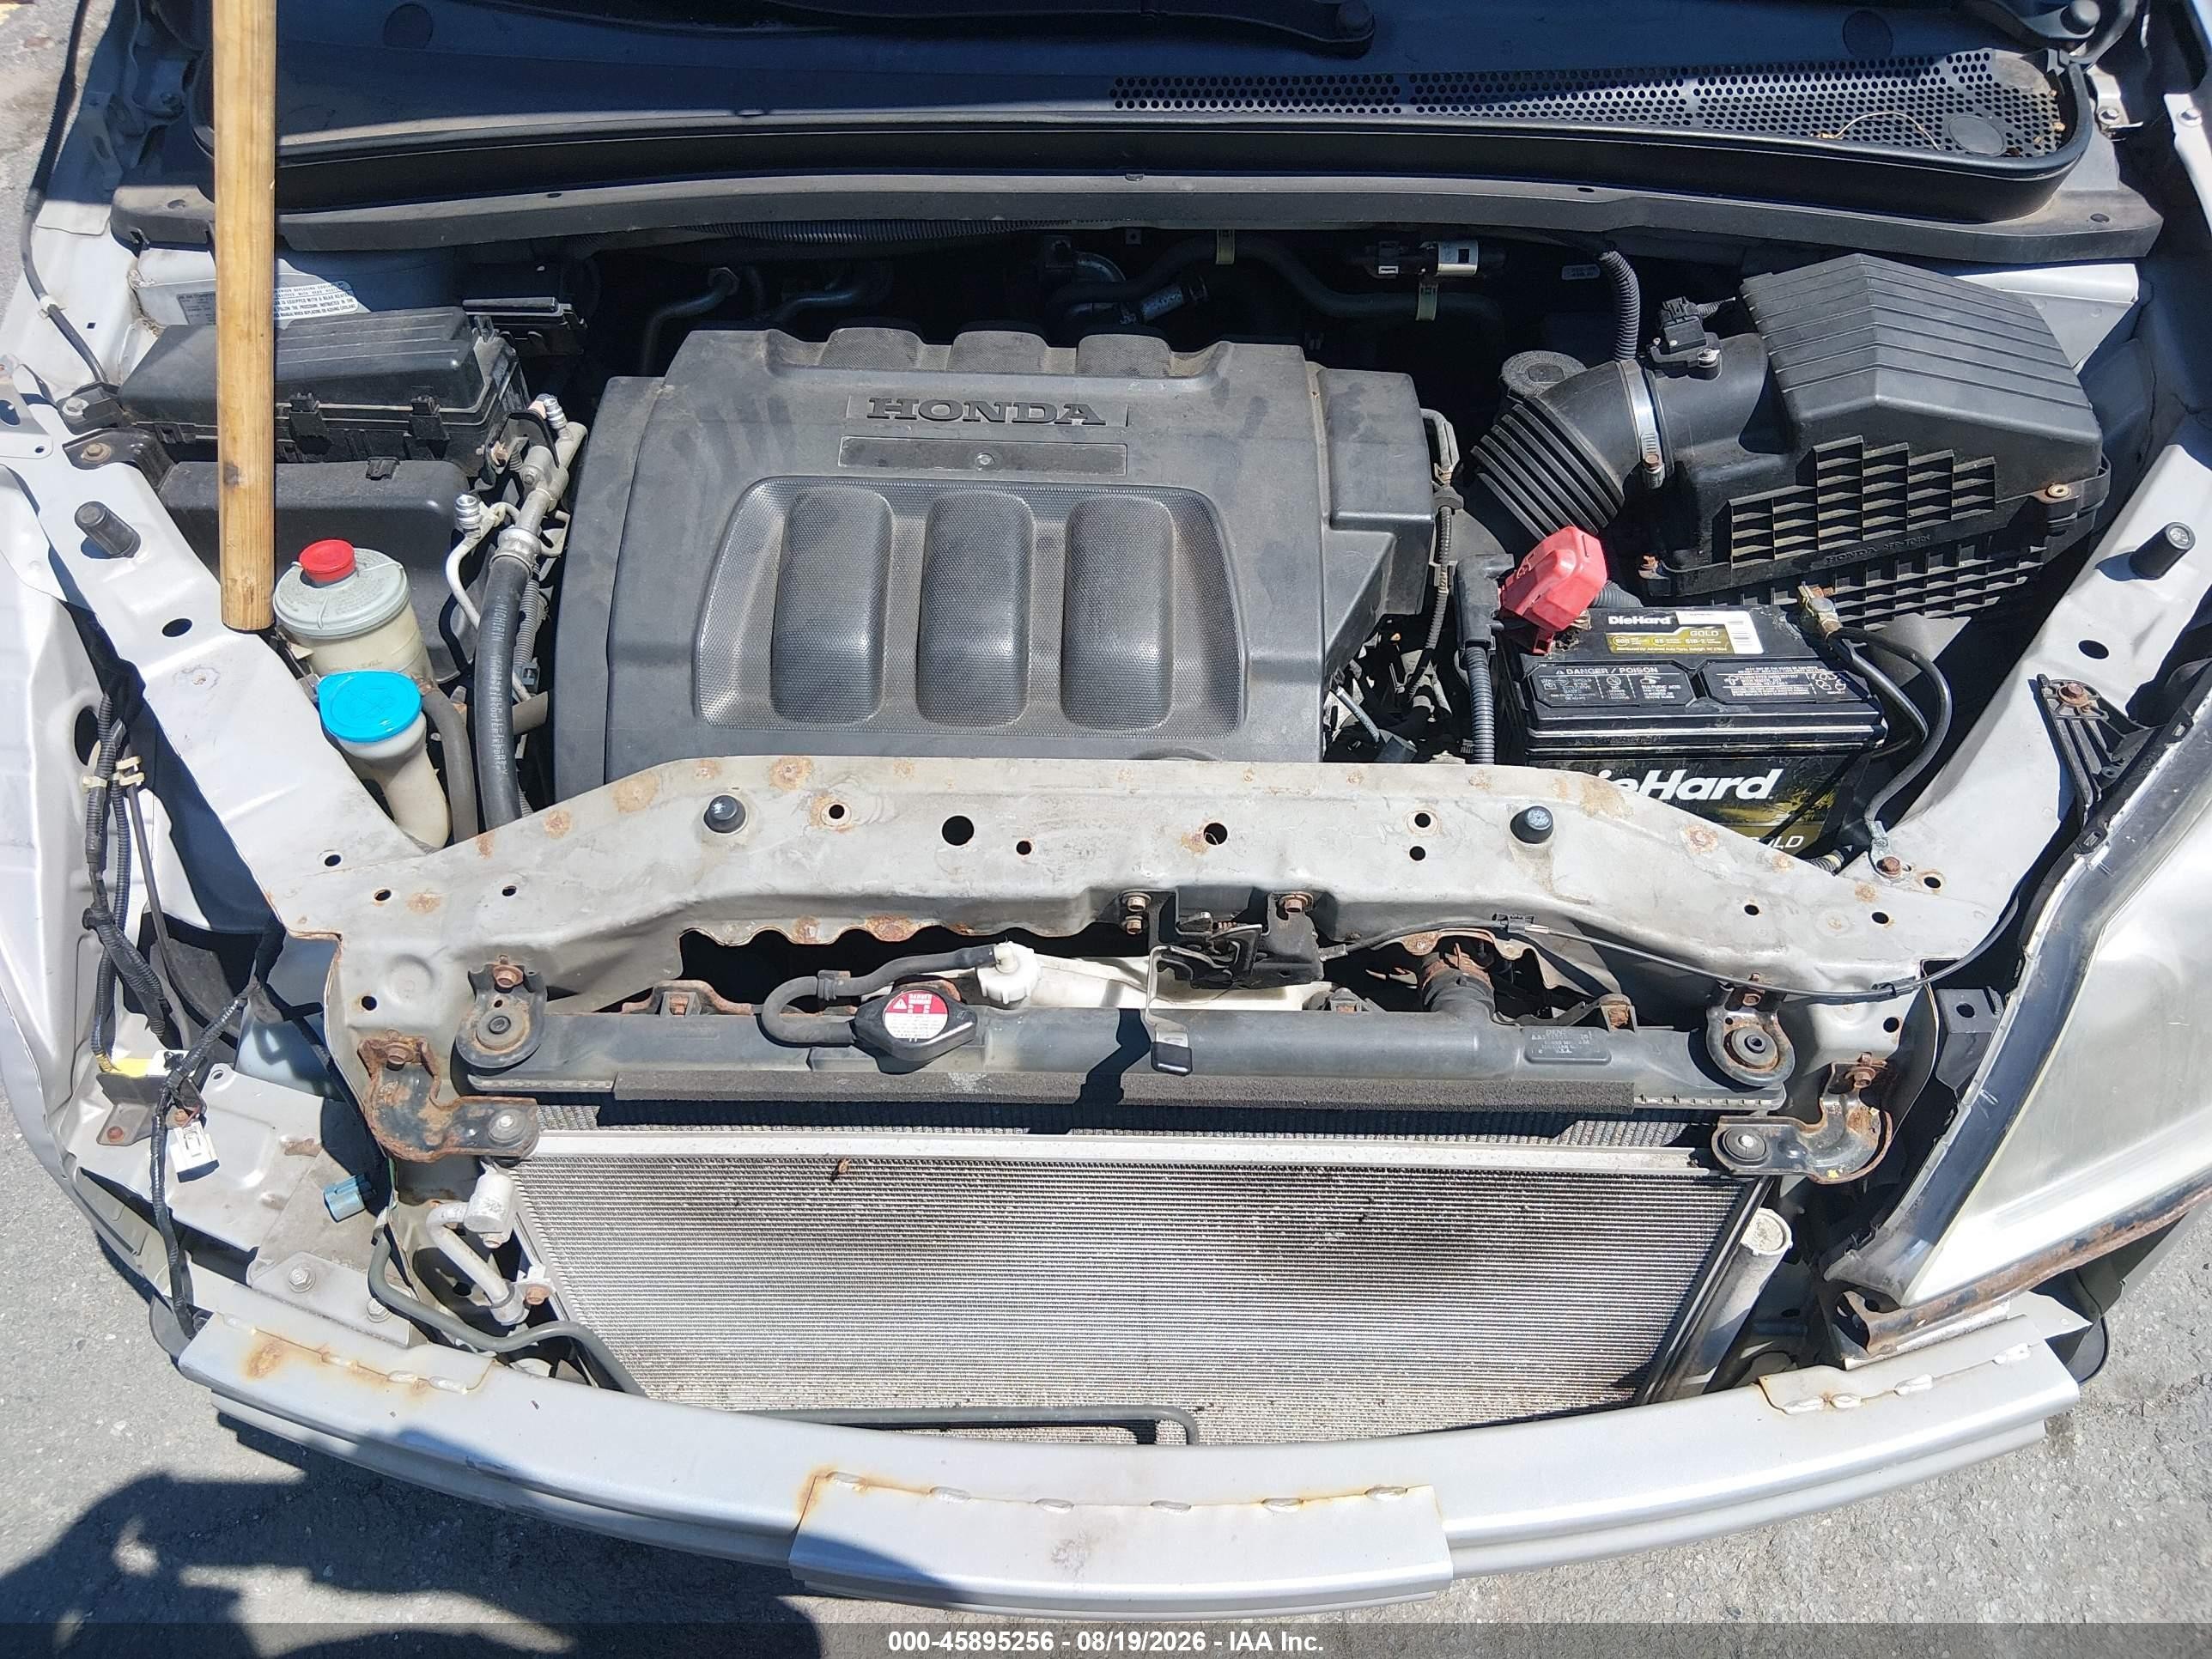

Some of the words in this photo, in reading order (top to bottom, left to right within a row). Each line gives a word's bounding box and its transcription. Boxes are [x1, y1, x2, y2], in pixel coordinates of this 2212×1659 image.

[866, 397, 1107, 426] HONDA
[1826, 547, 1878, 563] HONDA
[1608, 616, 1672, 625] DieHard
